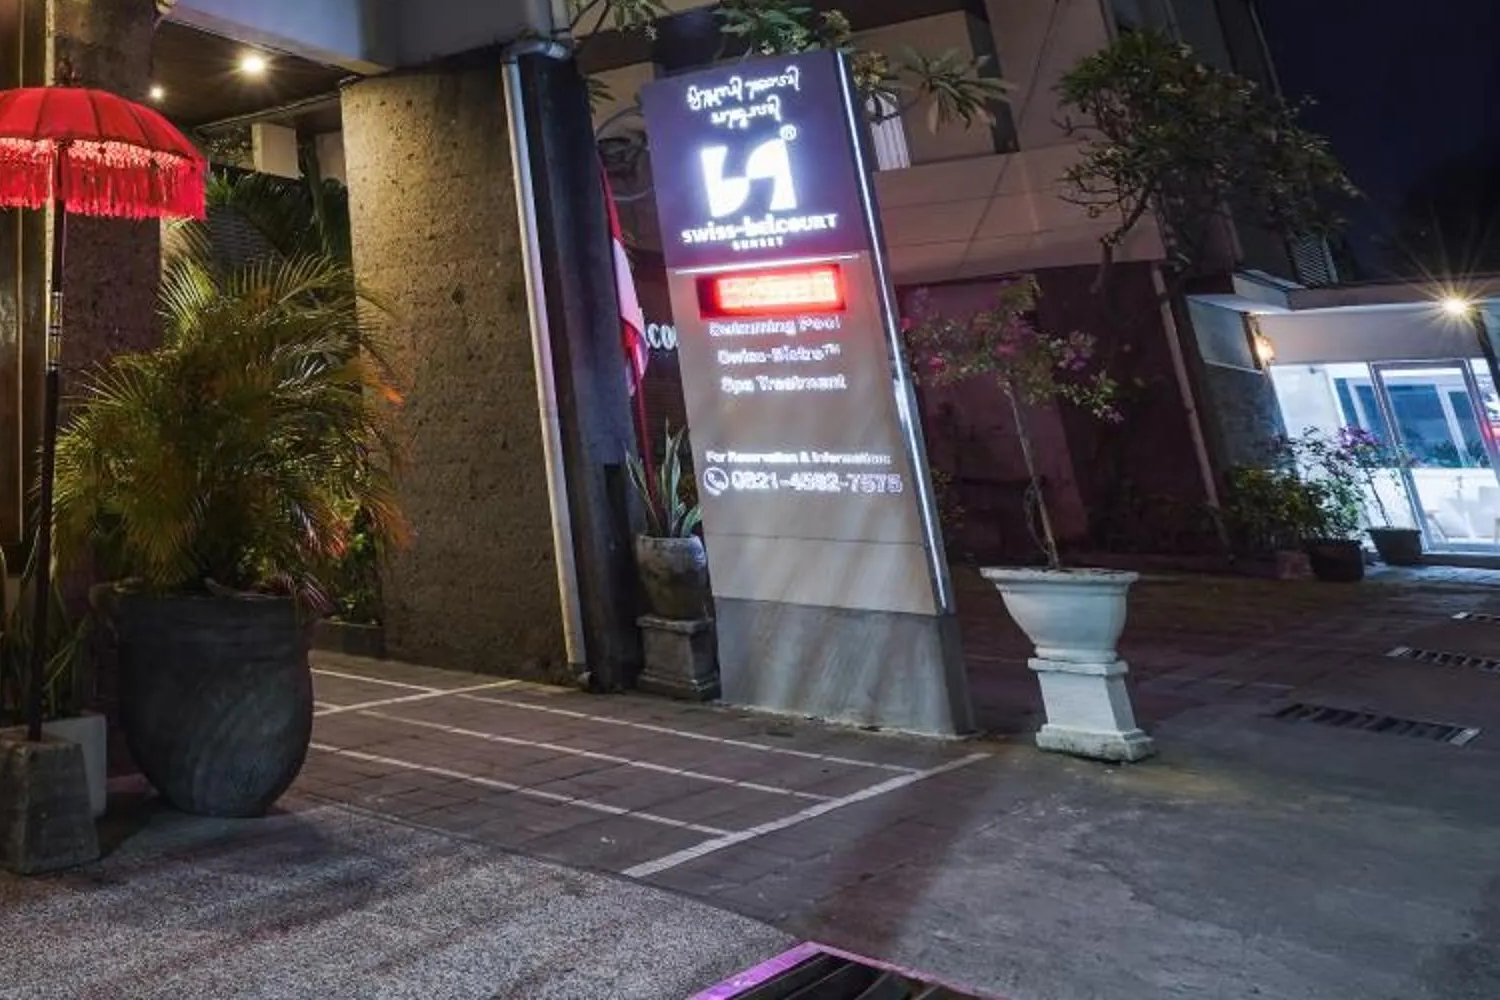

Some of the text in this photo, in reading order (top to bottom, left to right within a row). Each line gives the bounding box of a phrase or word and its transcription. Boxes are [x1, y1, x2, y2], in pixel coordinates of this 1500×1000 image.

[709, 315, 841, 337] Swimming Pool
[721, 373, 847, 394] Spa Treatment
[706, 451, 727, 464] For
